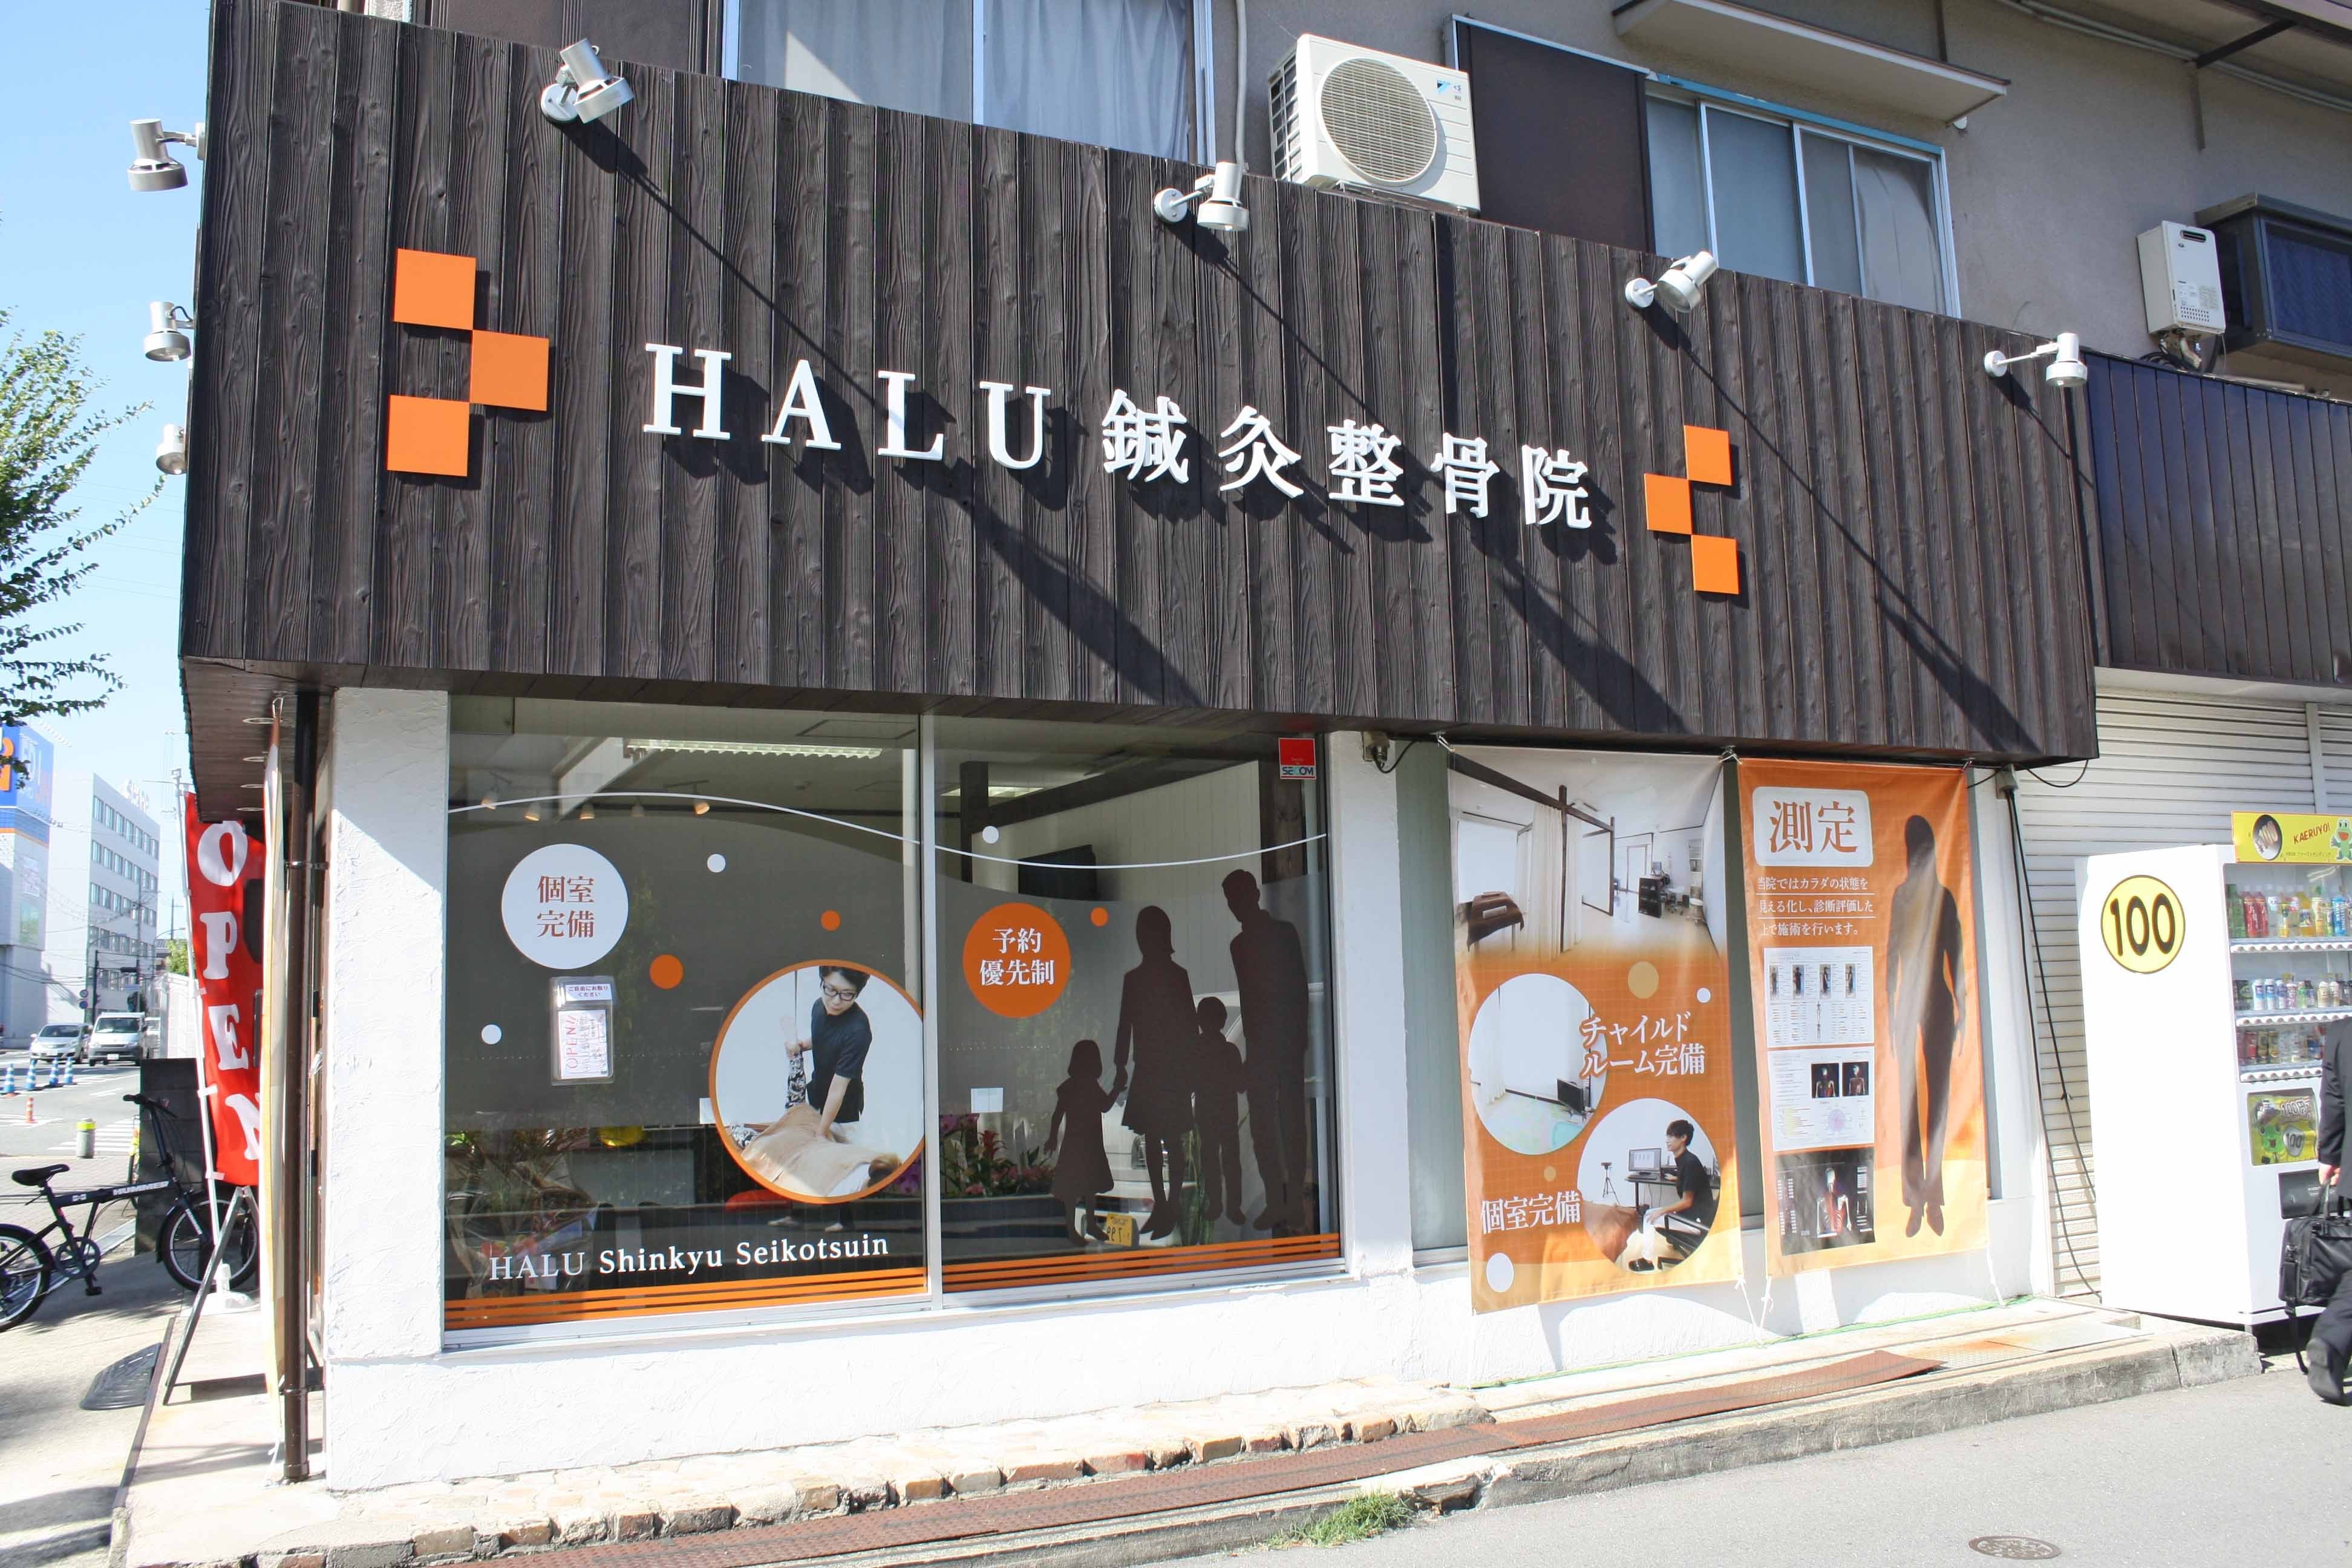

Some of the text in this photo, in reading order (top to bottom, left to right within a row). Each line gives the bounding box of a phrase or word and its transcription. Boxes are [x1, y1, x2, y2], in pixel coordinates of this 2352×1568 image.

[643, 343, 1592, 529] HALU 鍼灸整骨院
[1768, 800, 1858, 853] 測定
[537, 875, 595, 903] 個室
[1757, 877, 1869, 890] 当院ではカラダの状態を
[1759, 899, 1873, 913] 見える化し、診断評価した
[537, 909, 595, 938] 完備
[1761, 922, 1858, 936] 上で施術を行います。
[2109, 893, 2176, 956] 100
[992, 927, 1042, 954] 予約
[979, 959, 1055, 986] 優先制
[1581, 1011, 1691, 1047] チャイルド
[1581, 1043, 1706, 1077] ルーム完備
[1480, 1190, 1581, 1235] 個室完備
[489, 1233, 889, 1281] HALU Shinkyu Seikotsuin
